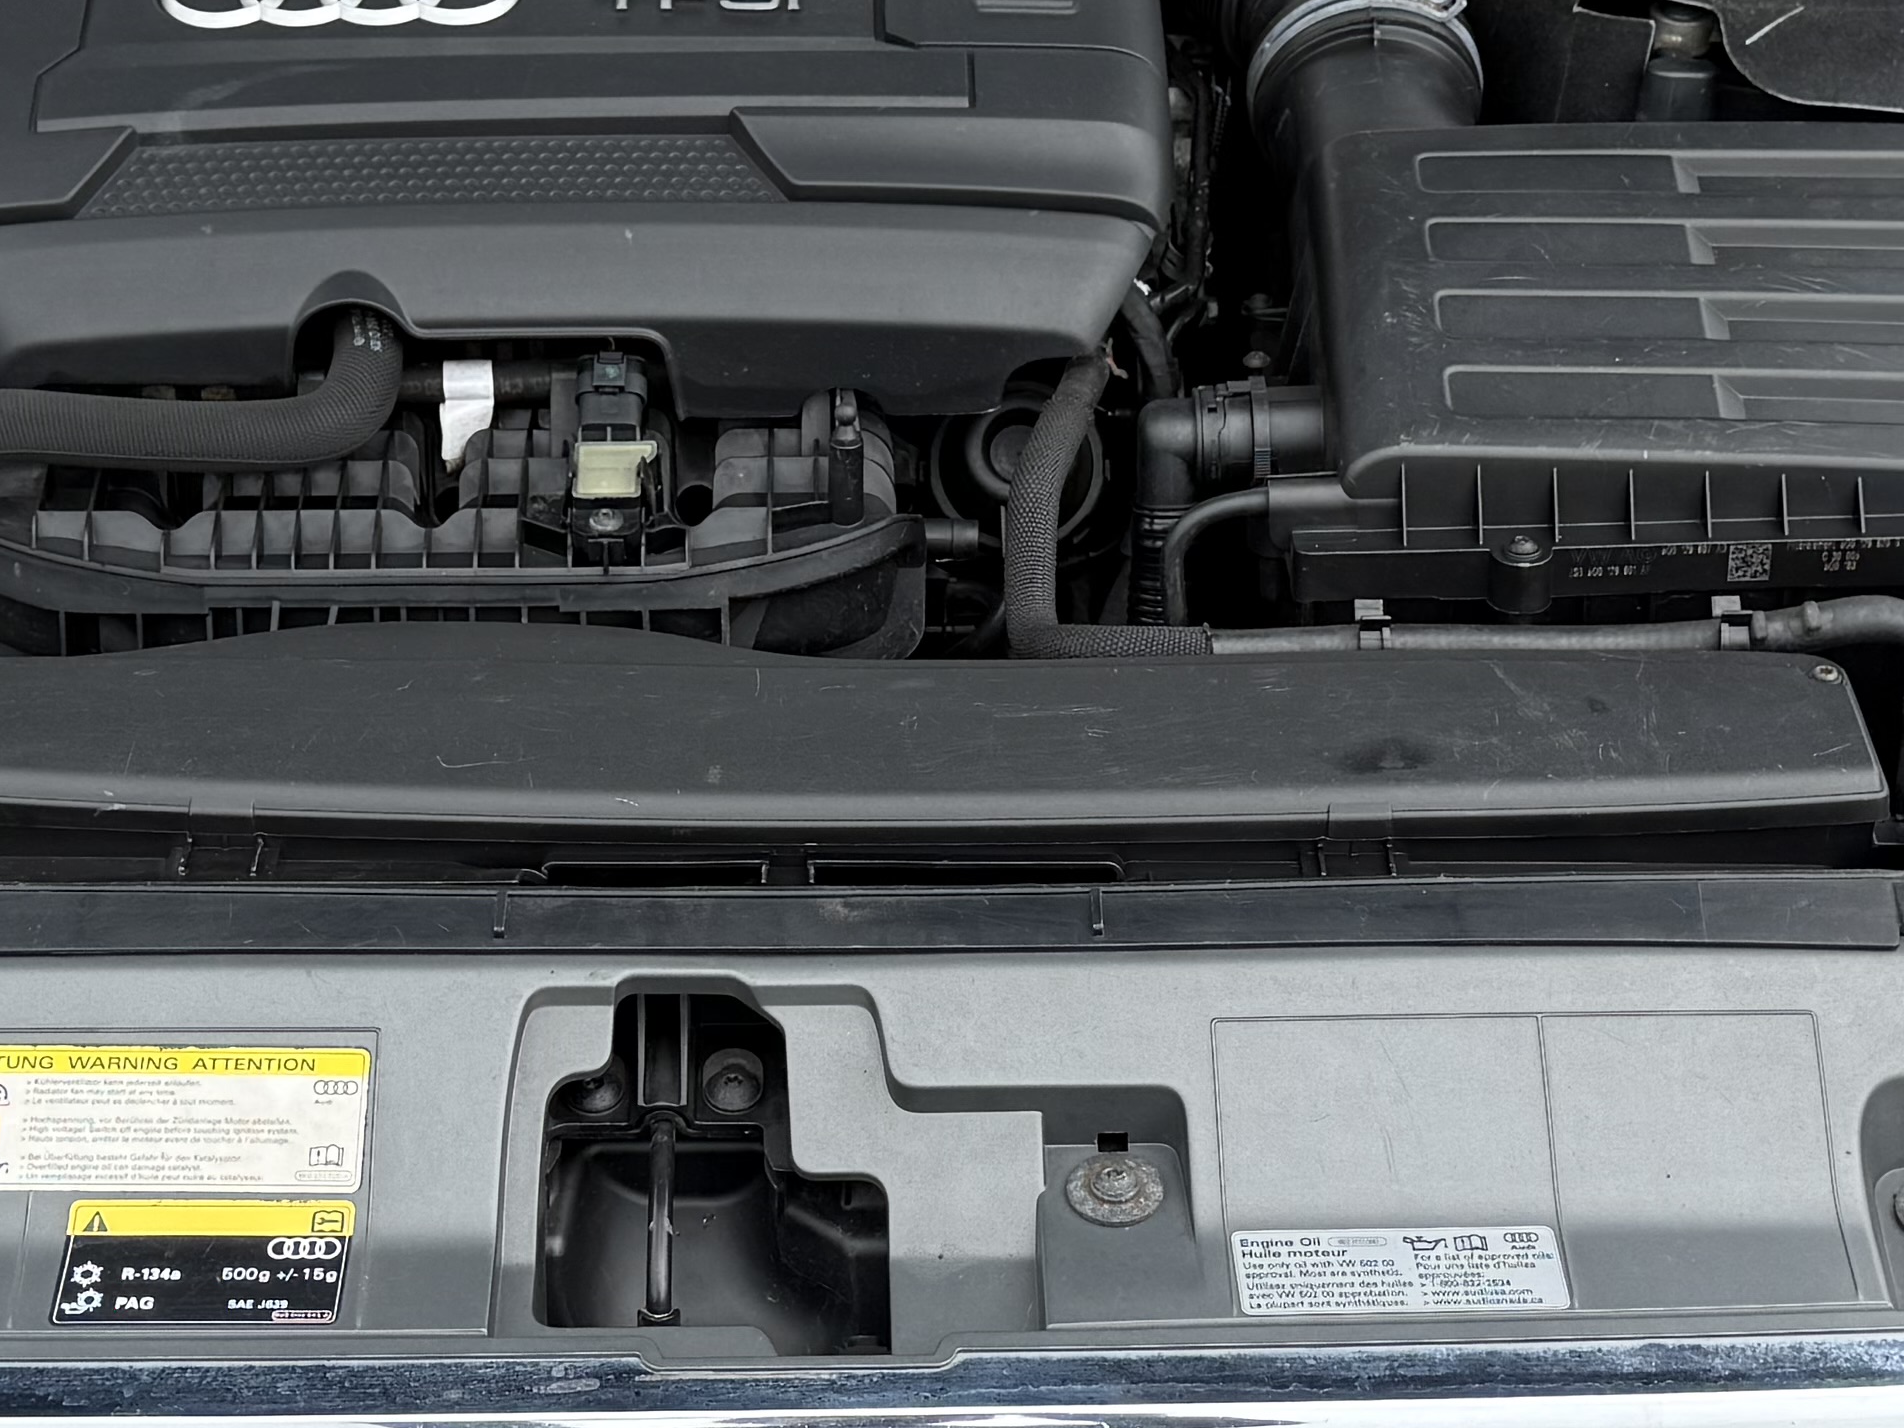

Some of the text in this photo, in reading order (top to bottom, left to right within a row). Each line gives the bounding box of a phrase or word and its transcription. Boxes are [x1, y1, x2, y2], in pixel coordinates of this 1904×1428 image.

[68, 1055, 179, 1072] WARNING
[192, 1056, 317, 1073] ATTENTION
[1240, 1237, 1322, 1252] Engine Oil
[1241, 1248, 1348, 1259] Huile moteur
[1243, 1261, 1265, 1270] Use
[1267, 1261, 1292, 1271] only
[1294, 1261, 1308, 1269] oil
[1310, 1260, 1335, 1269] with
[1336, 1259, 1356, 1268] VW
[120, 1267, 182, 1282] R-134a
[221, 1267, 271, 1283] 500g
[302, 1267, 339, 1283] 15g
[1245, 1270, 1296, 1281] approval.
[1299, 1269, 1327, 1278] Most
[1329, 1270, 1348, 1278] are
[1358, 1280, 1379, 1289] des
[1275, 1290, 1296, 1300] VW
[114, 1296, 156, 1311] PAG
[227, 1298, 255, 1310] SAE
